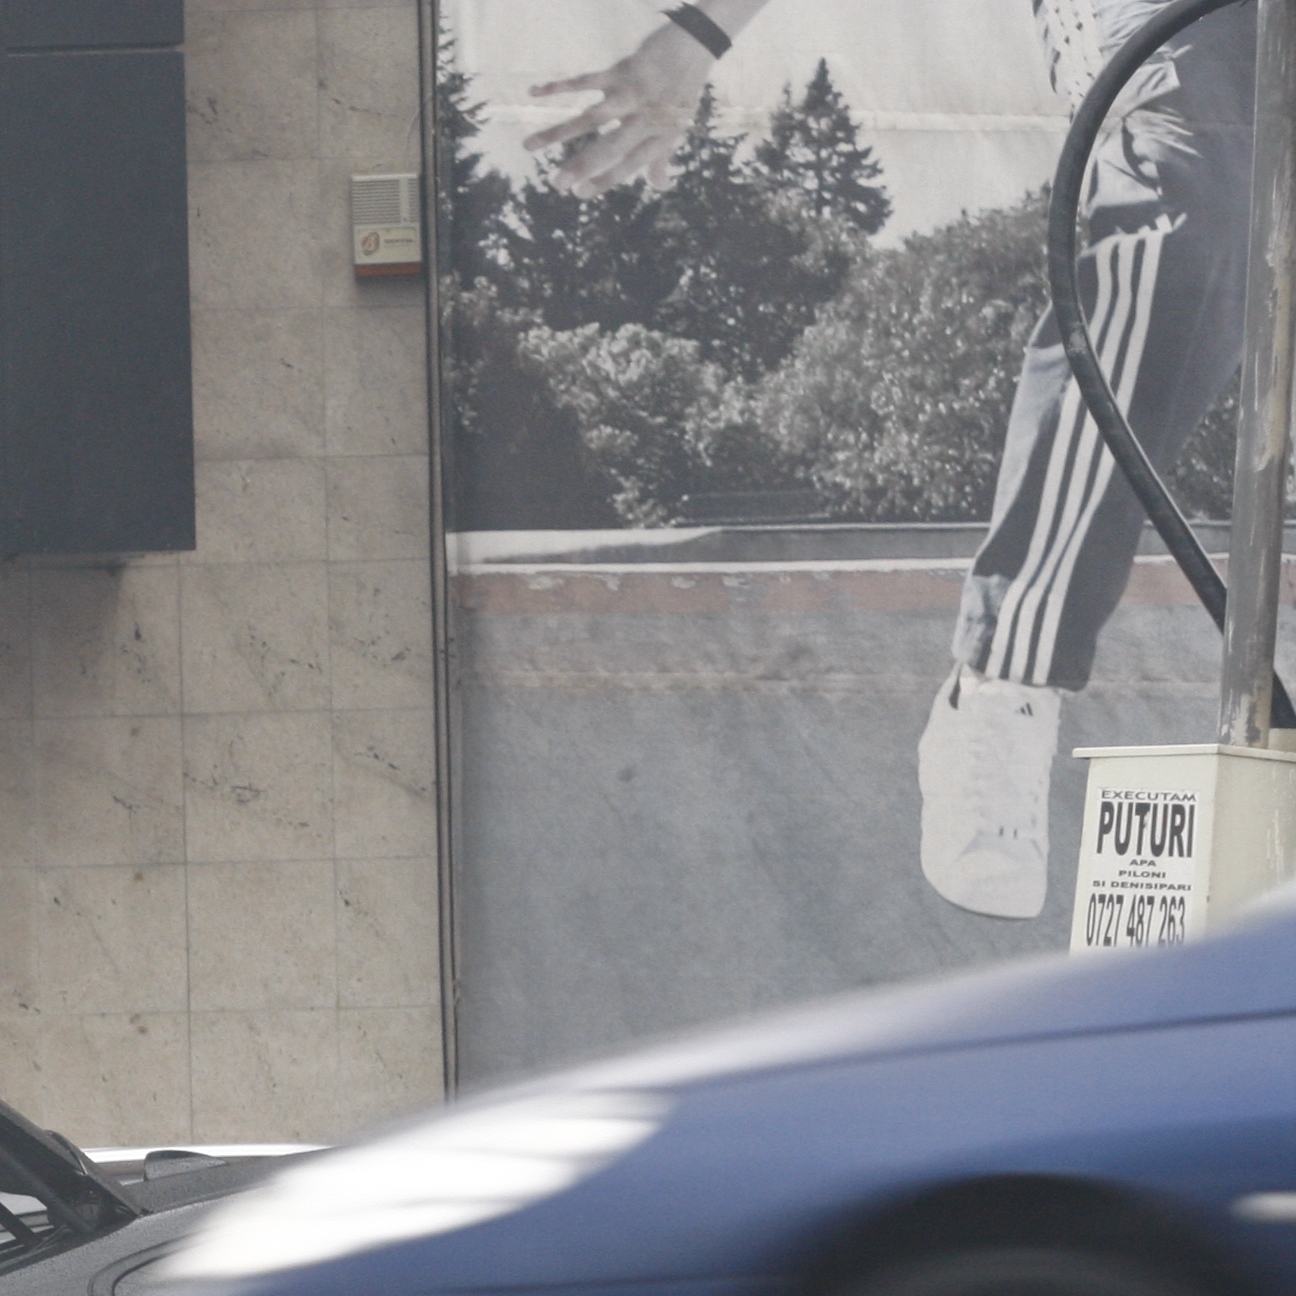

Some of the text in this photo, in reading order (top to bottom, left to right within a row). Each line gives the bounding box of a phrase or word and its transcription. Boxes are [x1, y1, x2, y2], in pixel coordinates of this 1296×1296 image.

[1101, 790, 1196, 802] EXECUTAM
[1096, 801, 1195, 858] PUTURI
[1129, 859, 1157, 867] APA
[1118, 870, 1166, 879] PILONI
[1092, 880, 1191, 891] SI DENISIPARI
[1086, 893, 1185, 948] 0727 487 263
